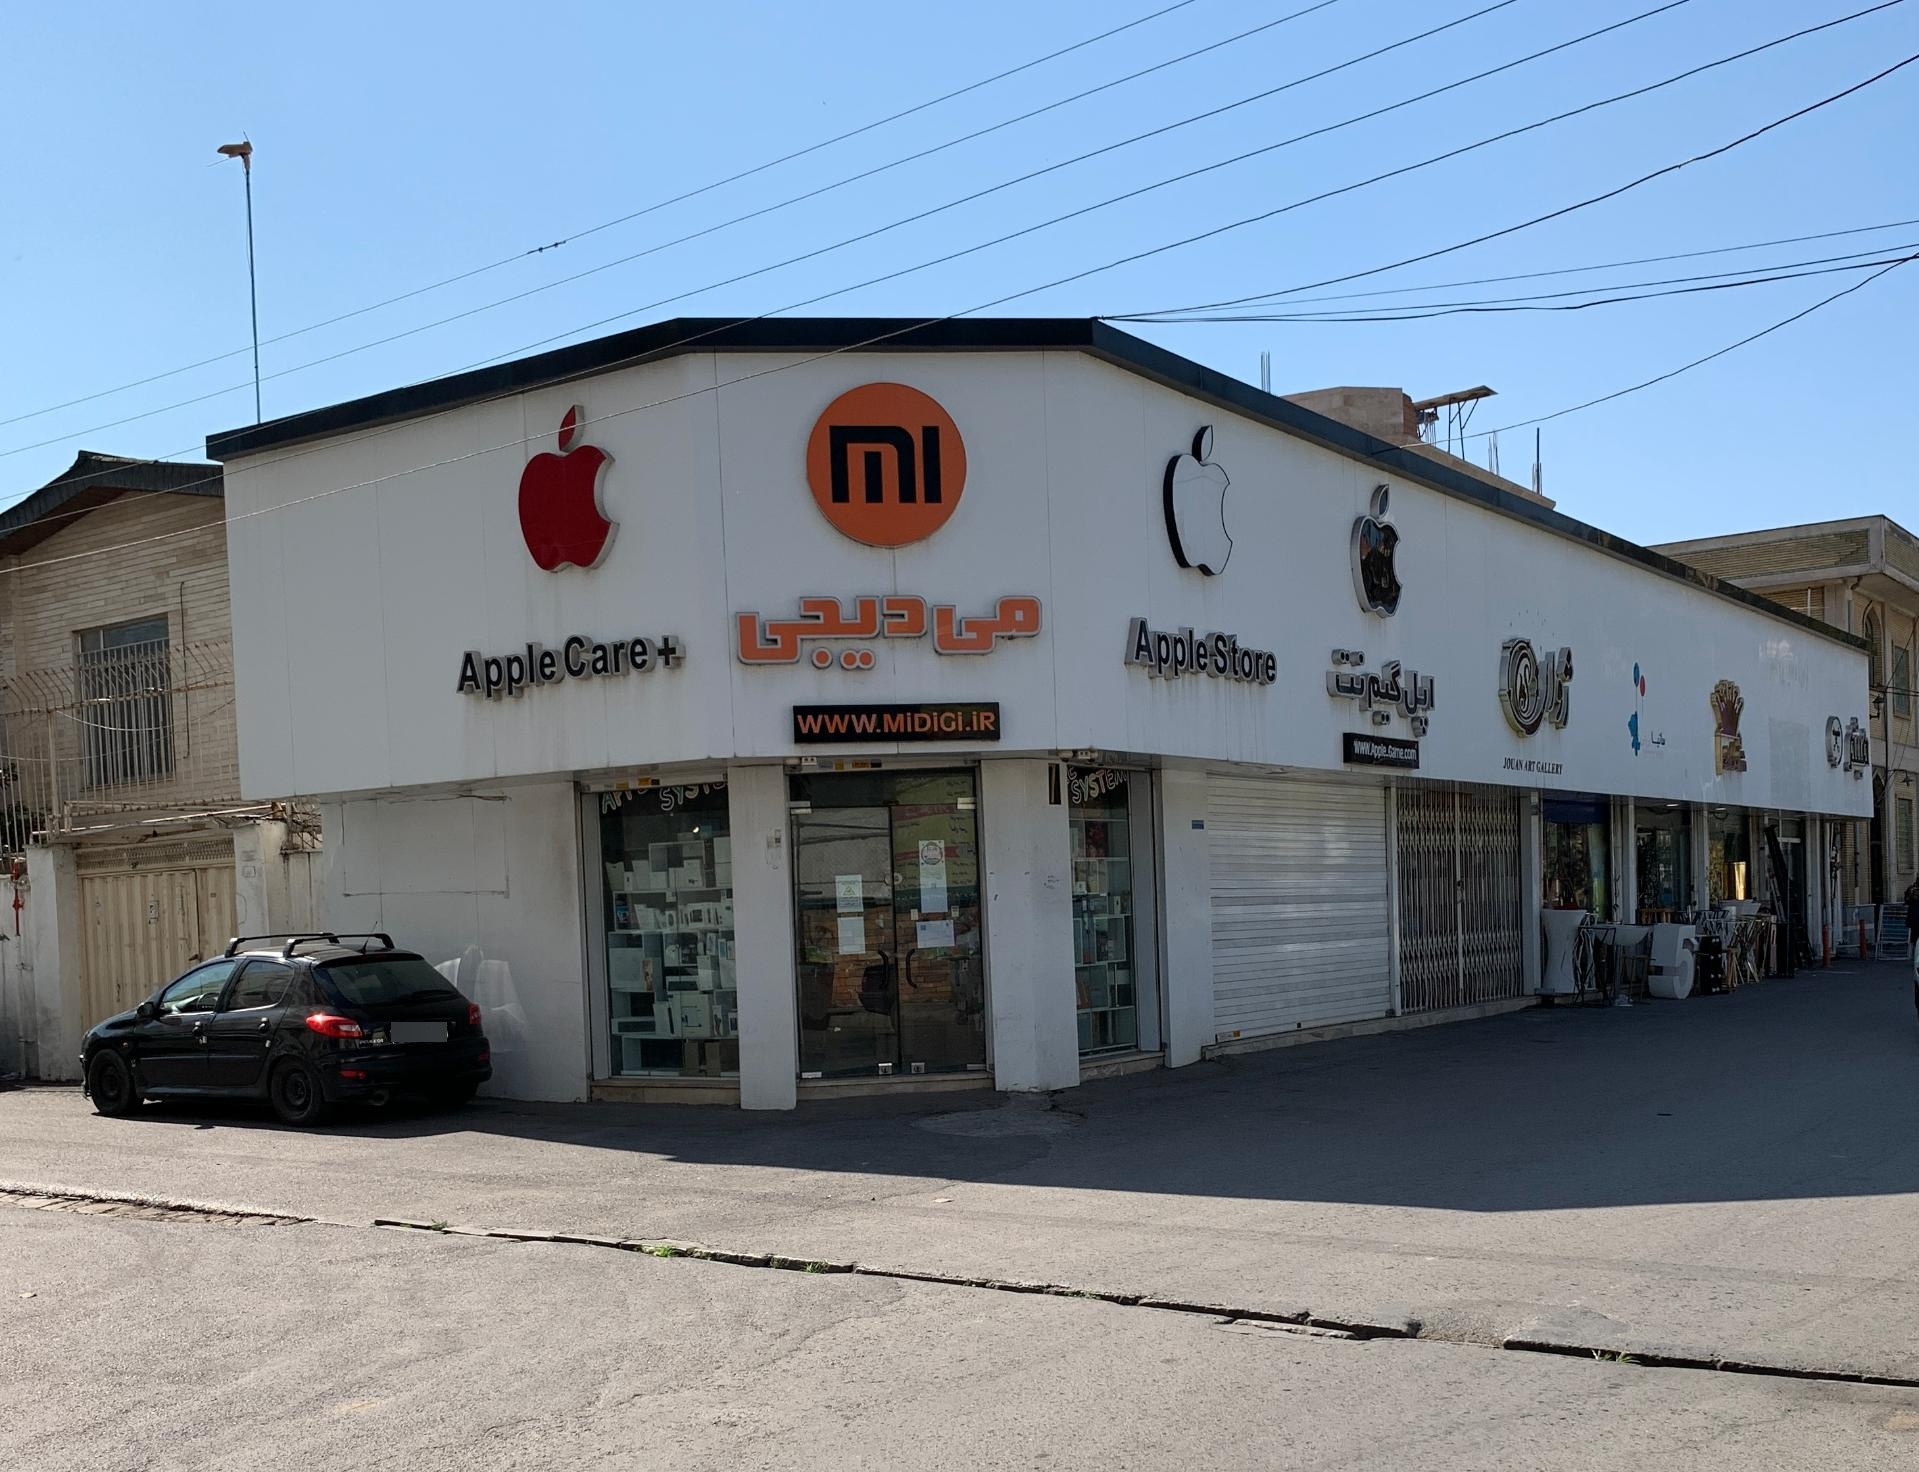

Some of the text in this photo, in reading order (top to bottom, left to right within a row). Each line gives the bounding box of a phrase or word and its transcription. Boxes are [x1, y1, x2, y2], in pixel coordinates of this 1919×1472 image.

[736, 595, 1044, 670] می دیجی
[1129, 618, 1278, 685] Apple Store
[456, 641, 562, 699] Apple
[1326, 649, 1435, 738] اپل گیم نت
[1524, 760, 1536, 772] ART
[1536, 761, 1563, 775] GALLERY
